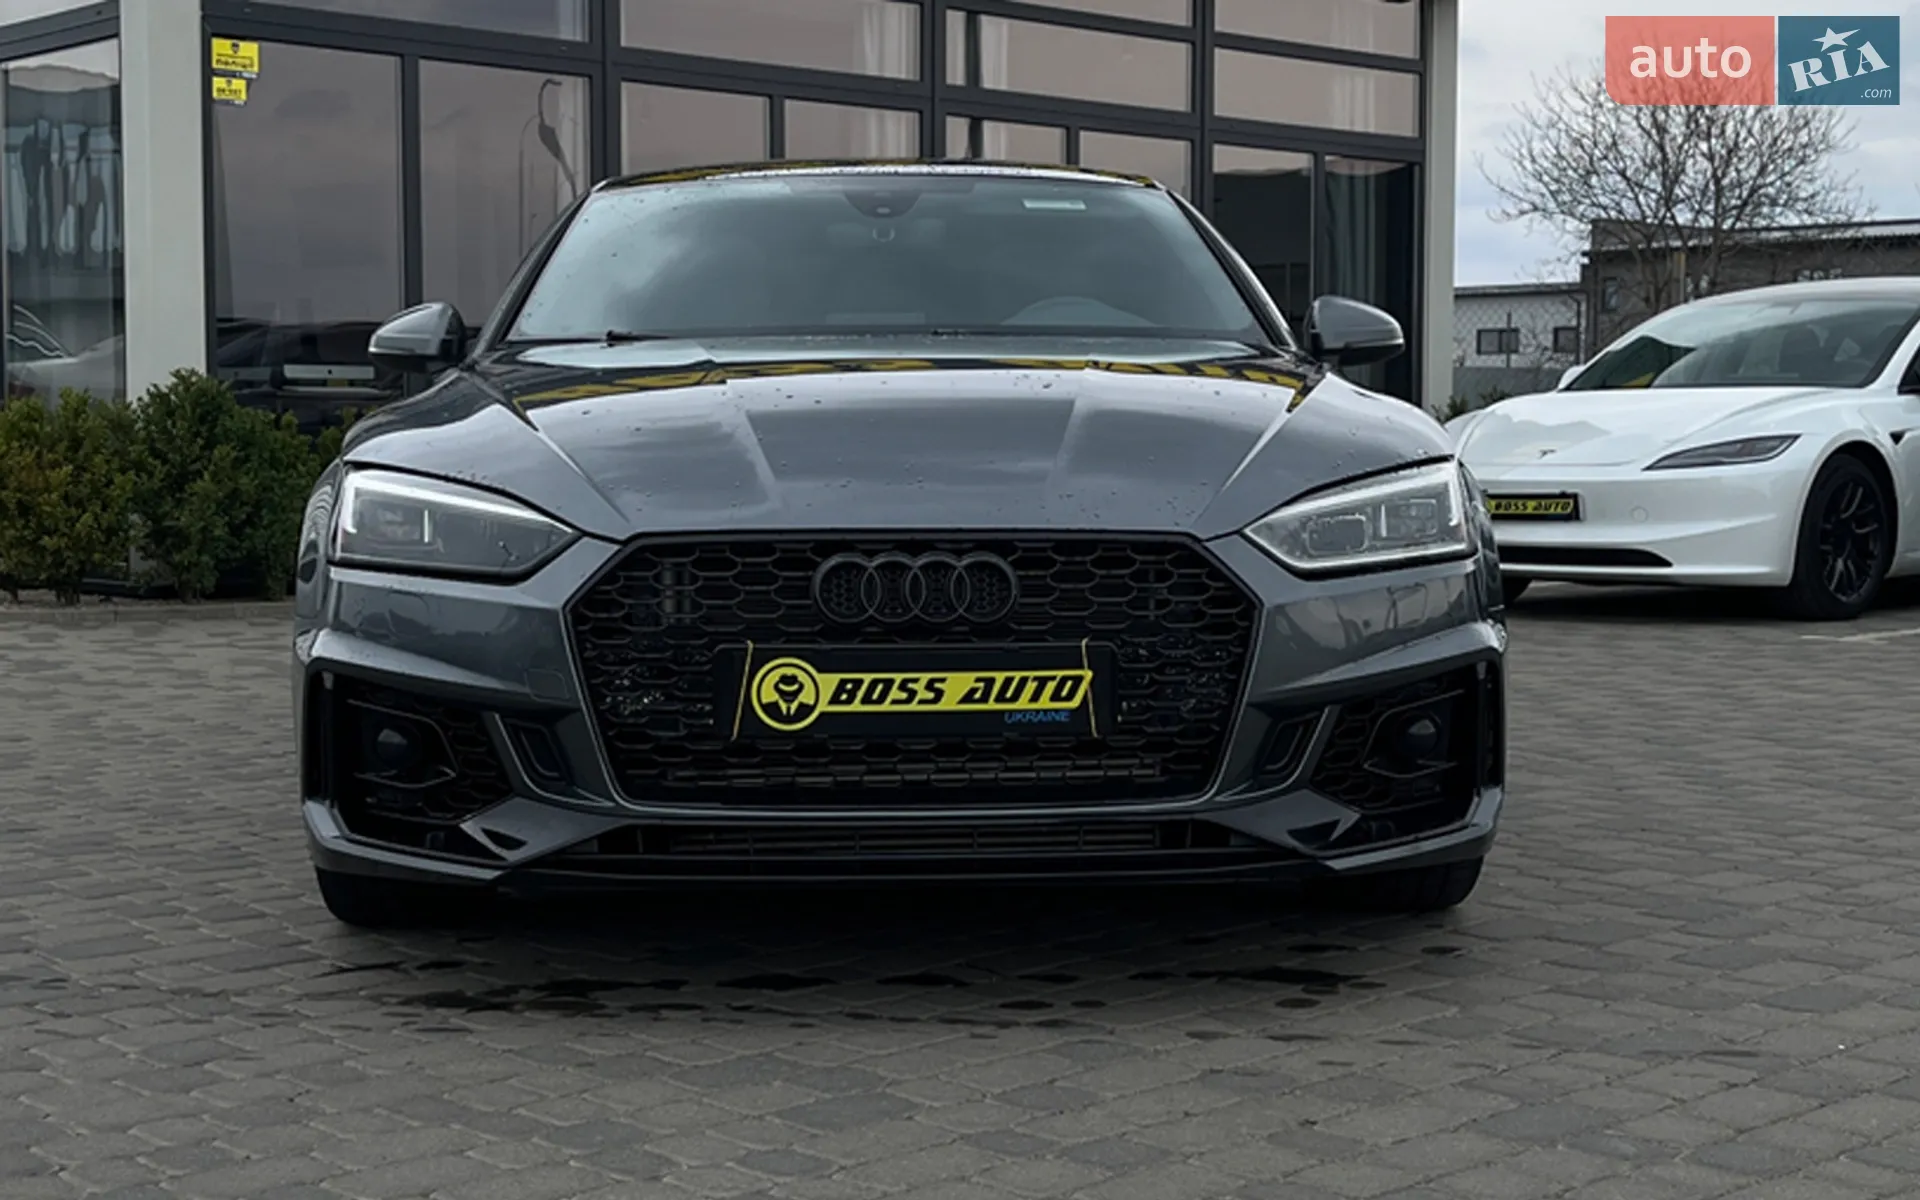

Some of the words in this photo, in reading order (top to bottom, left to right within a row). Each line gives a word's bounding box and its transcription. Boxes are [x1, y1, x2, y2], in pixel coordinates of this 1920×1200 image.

[1494, 501, 1528, 512] BOSS
[1533, 501, 1571, 512] AUTO
[827, 677, 948, 706] BOSS
[956, 675, 1085, 705] AUTO
[1004, 709, 1071, 724] UKRAINE
